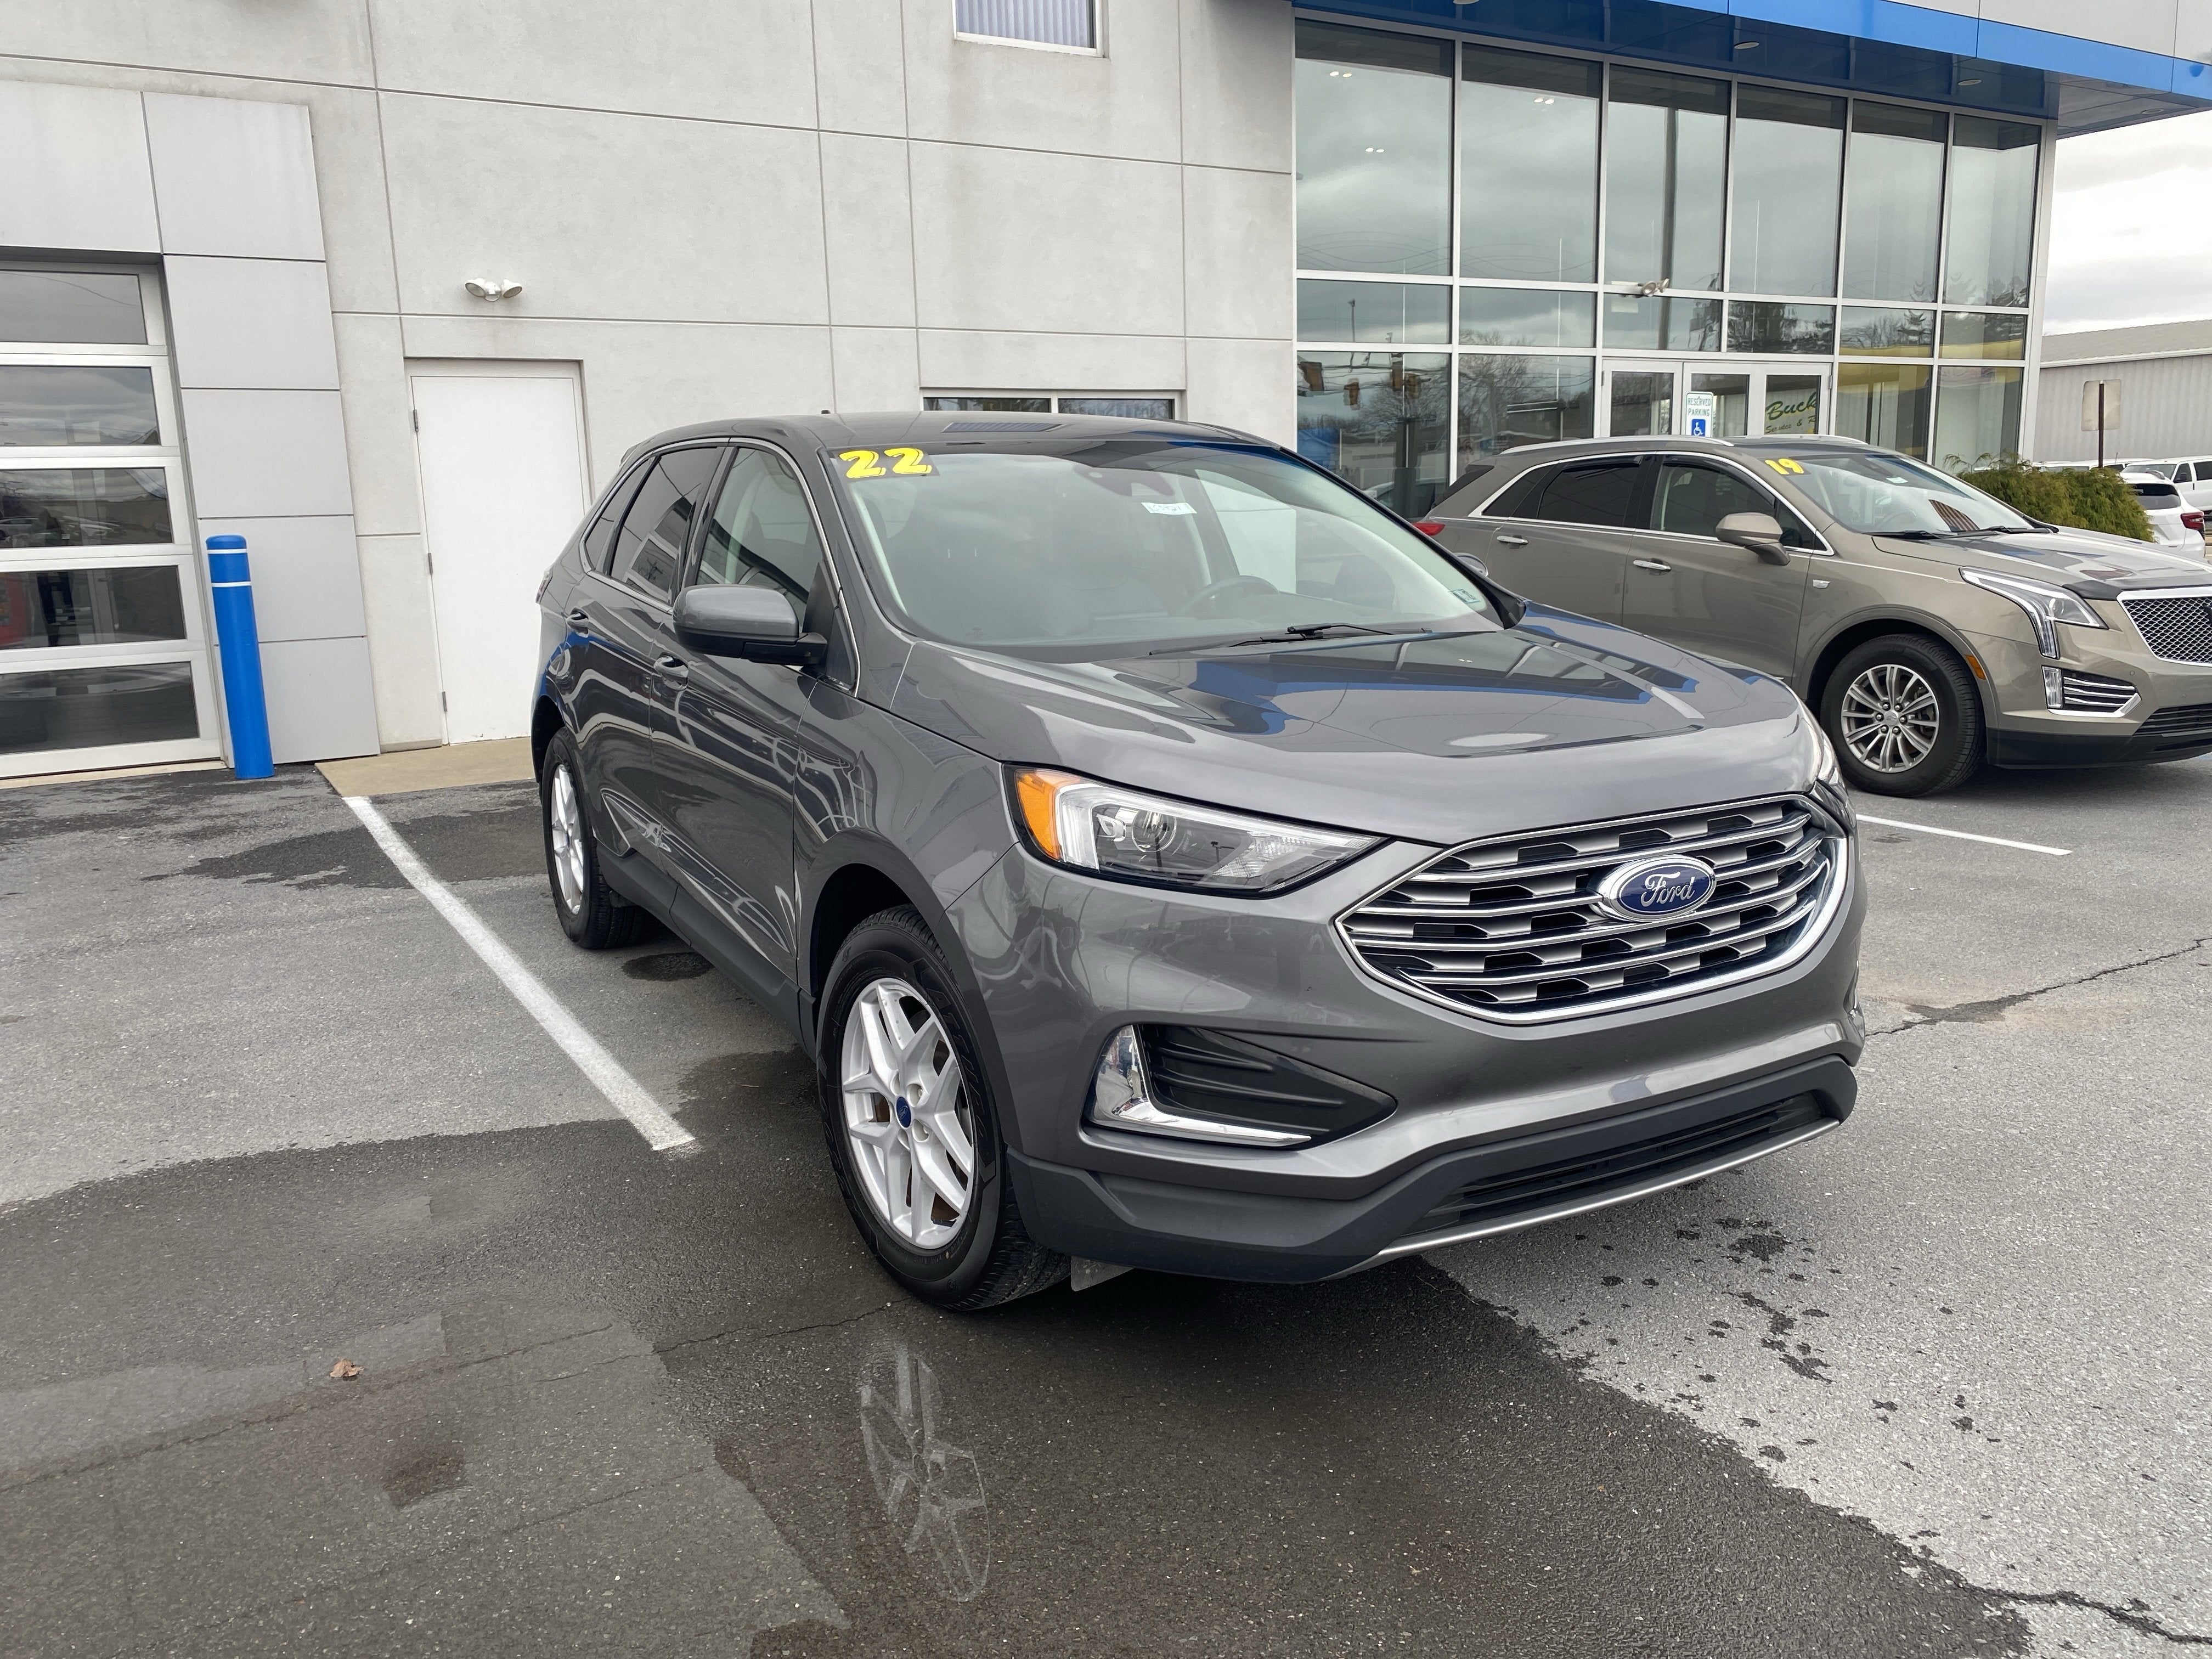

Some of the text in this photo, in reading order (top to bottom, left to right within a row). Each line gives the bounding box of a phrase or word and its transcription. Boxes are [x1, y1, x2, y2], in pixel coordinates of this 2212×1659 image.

[1688, 398, 1711, 407] RESERVED
[1688, 408, 1710, 417] PARKING
[839, 448, 933, 479] 22
[1764, 458, 1804, 475] 19
[1640, 871, 1695, 907] Ford
